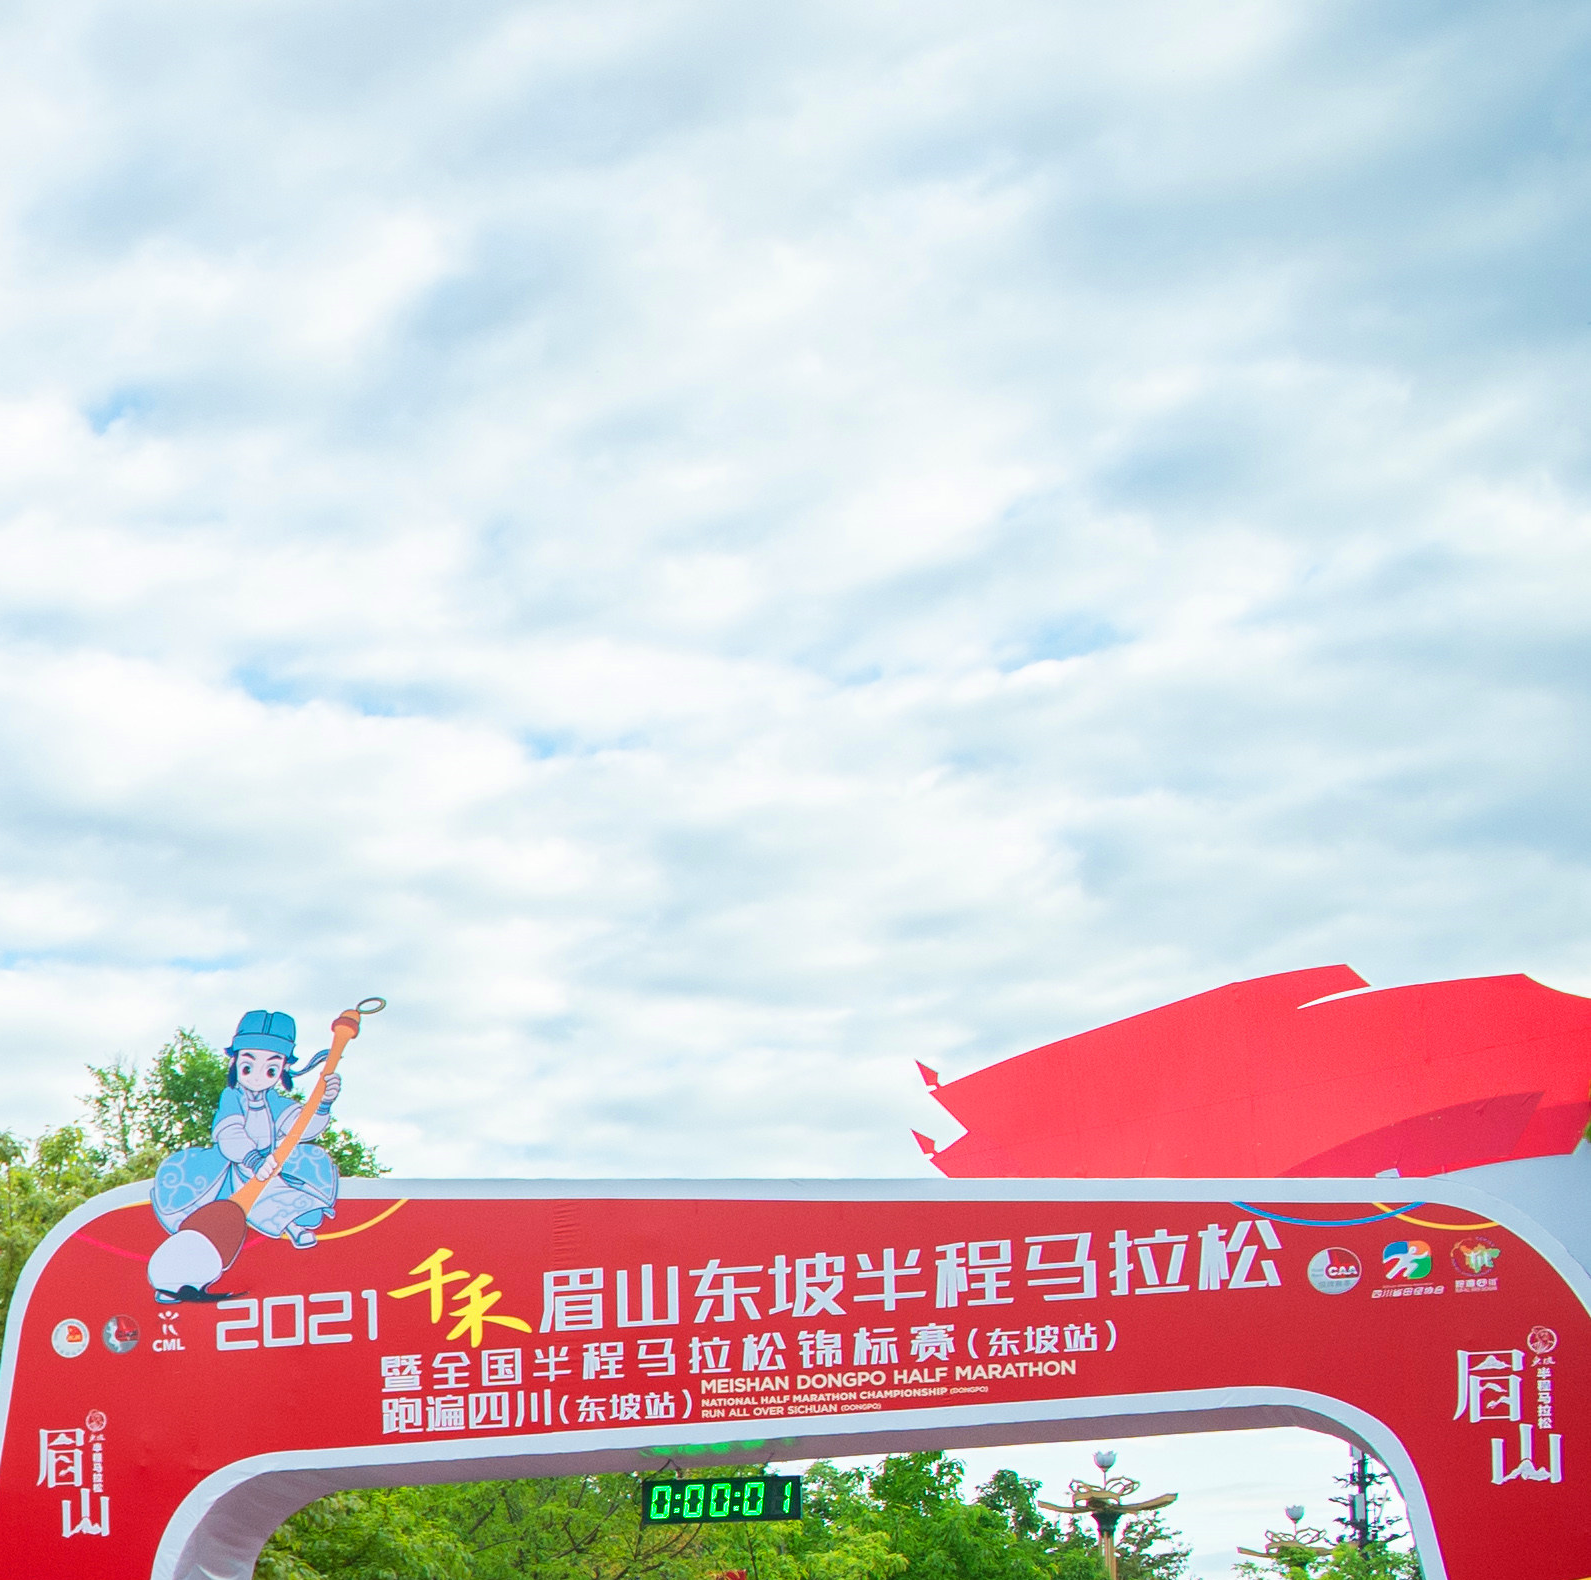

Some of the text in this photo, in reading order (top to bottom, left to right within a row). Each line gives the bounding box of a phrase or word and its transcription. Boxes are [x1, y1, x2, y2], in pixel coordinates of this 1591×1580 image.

[215, 1218, 1284, 1352] 2021 千禾 眉山东坡半程马拉松
[1327, 1264, 1358, 1277] CAA
[152, 1339, 186, 1352] CML
[700, 1359, 1077, 1395] MEISHAN DONGPO HALF MARATHON
[380, 1386, 693, 1436] 跑遍四川(东坡站)
[701, 1396, 758, 1408] NATIONAL
[760, 1394, 790, 1405] HALF
[793, 1391, 857, 1403] MARATHON
[859, 1386, 947, 1400] CHAMPIONSHIP
[701, 1402, 882, 1419] RUN ALL OVER SICHUAN (DONGPO)
[649, 1481, 793, 1520] 0:00:01
